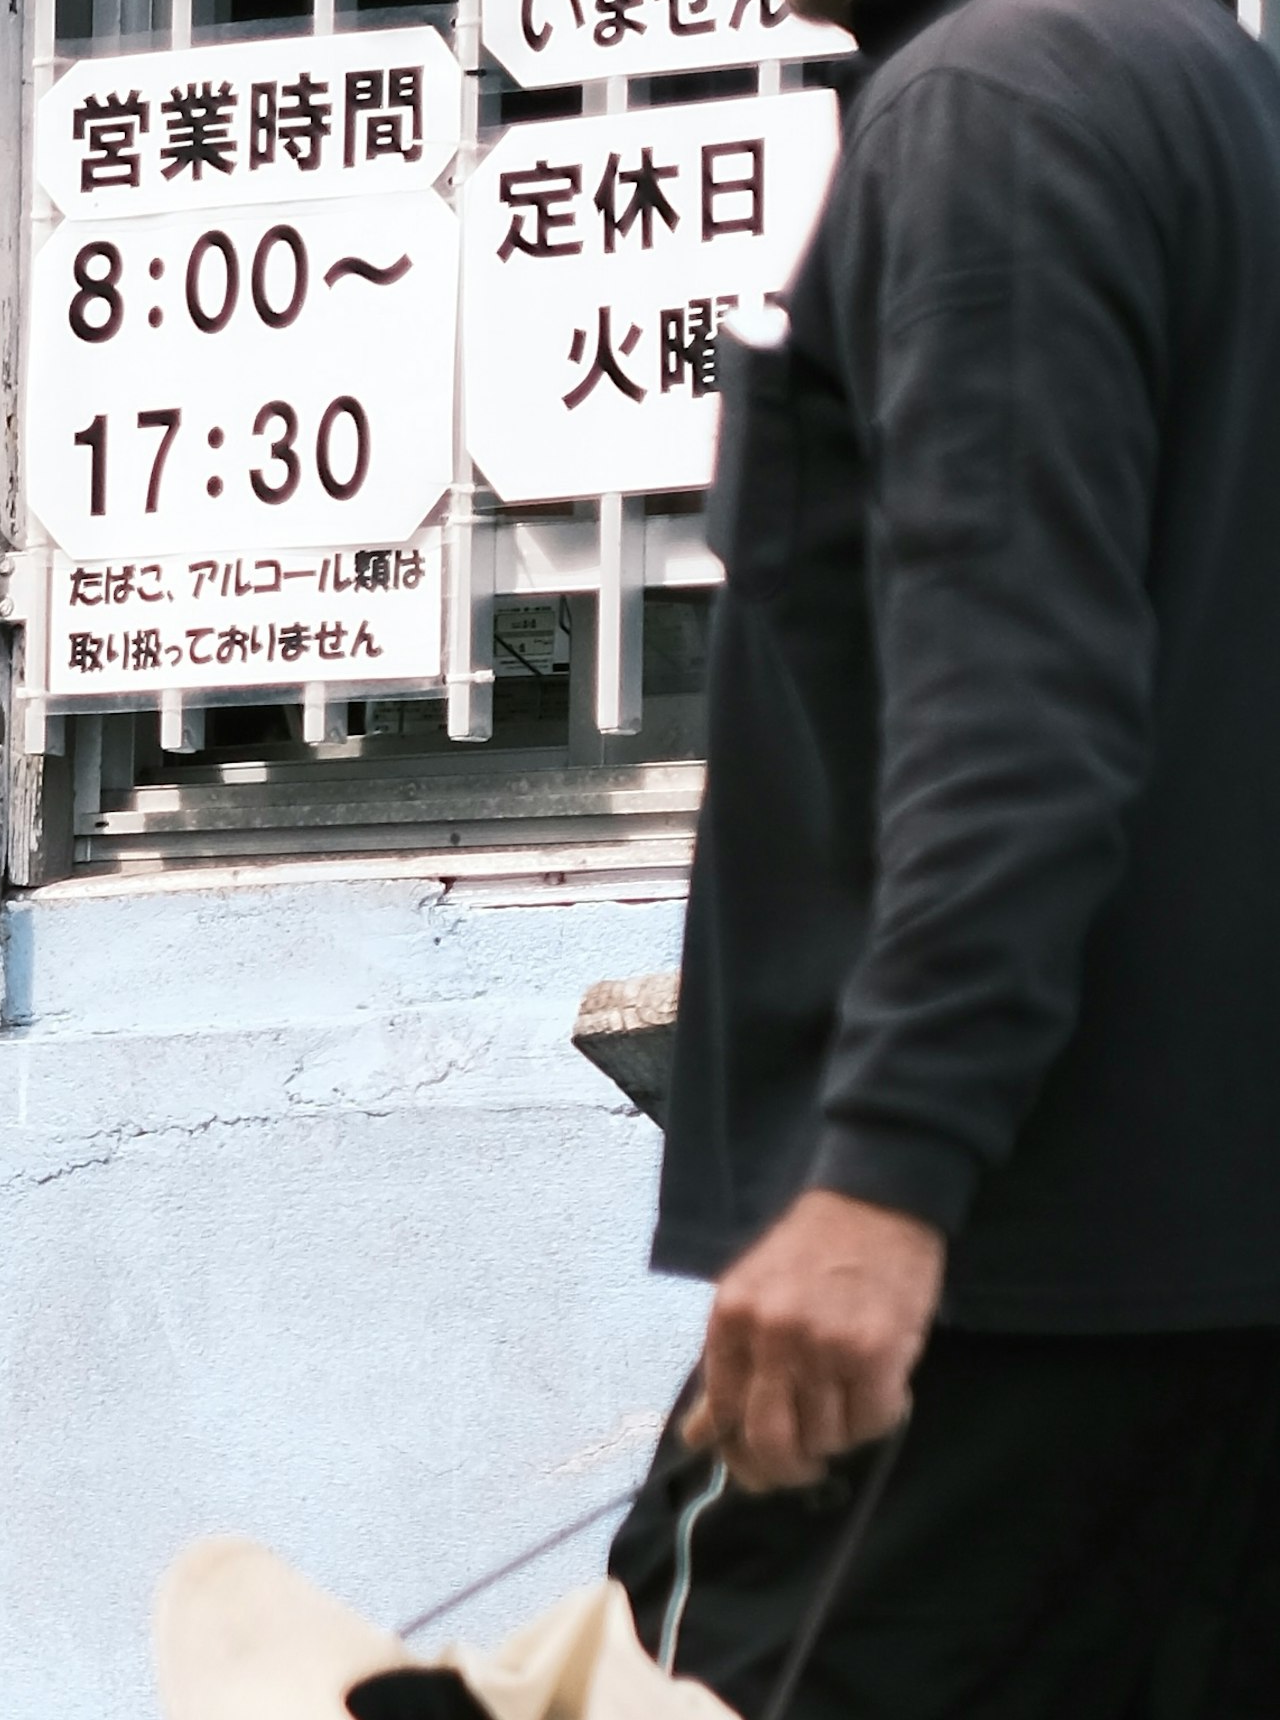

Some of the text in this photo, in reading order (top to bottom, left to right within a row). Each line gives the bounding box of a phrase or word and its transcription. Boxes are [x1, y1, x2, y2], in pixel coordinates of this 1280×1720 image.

[71, 66, 423, 194] 営業時間
[495, 139, 766, 264] 定休日
[562, 290, 787, 411] 火曜
[73, 396, 371, 516] 17:30
[69, 550, 425, 608] たばこ、アルコール類は
[67, 620, 383, 673] 取り扱っておりません
